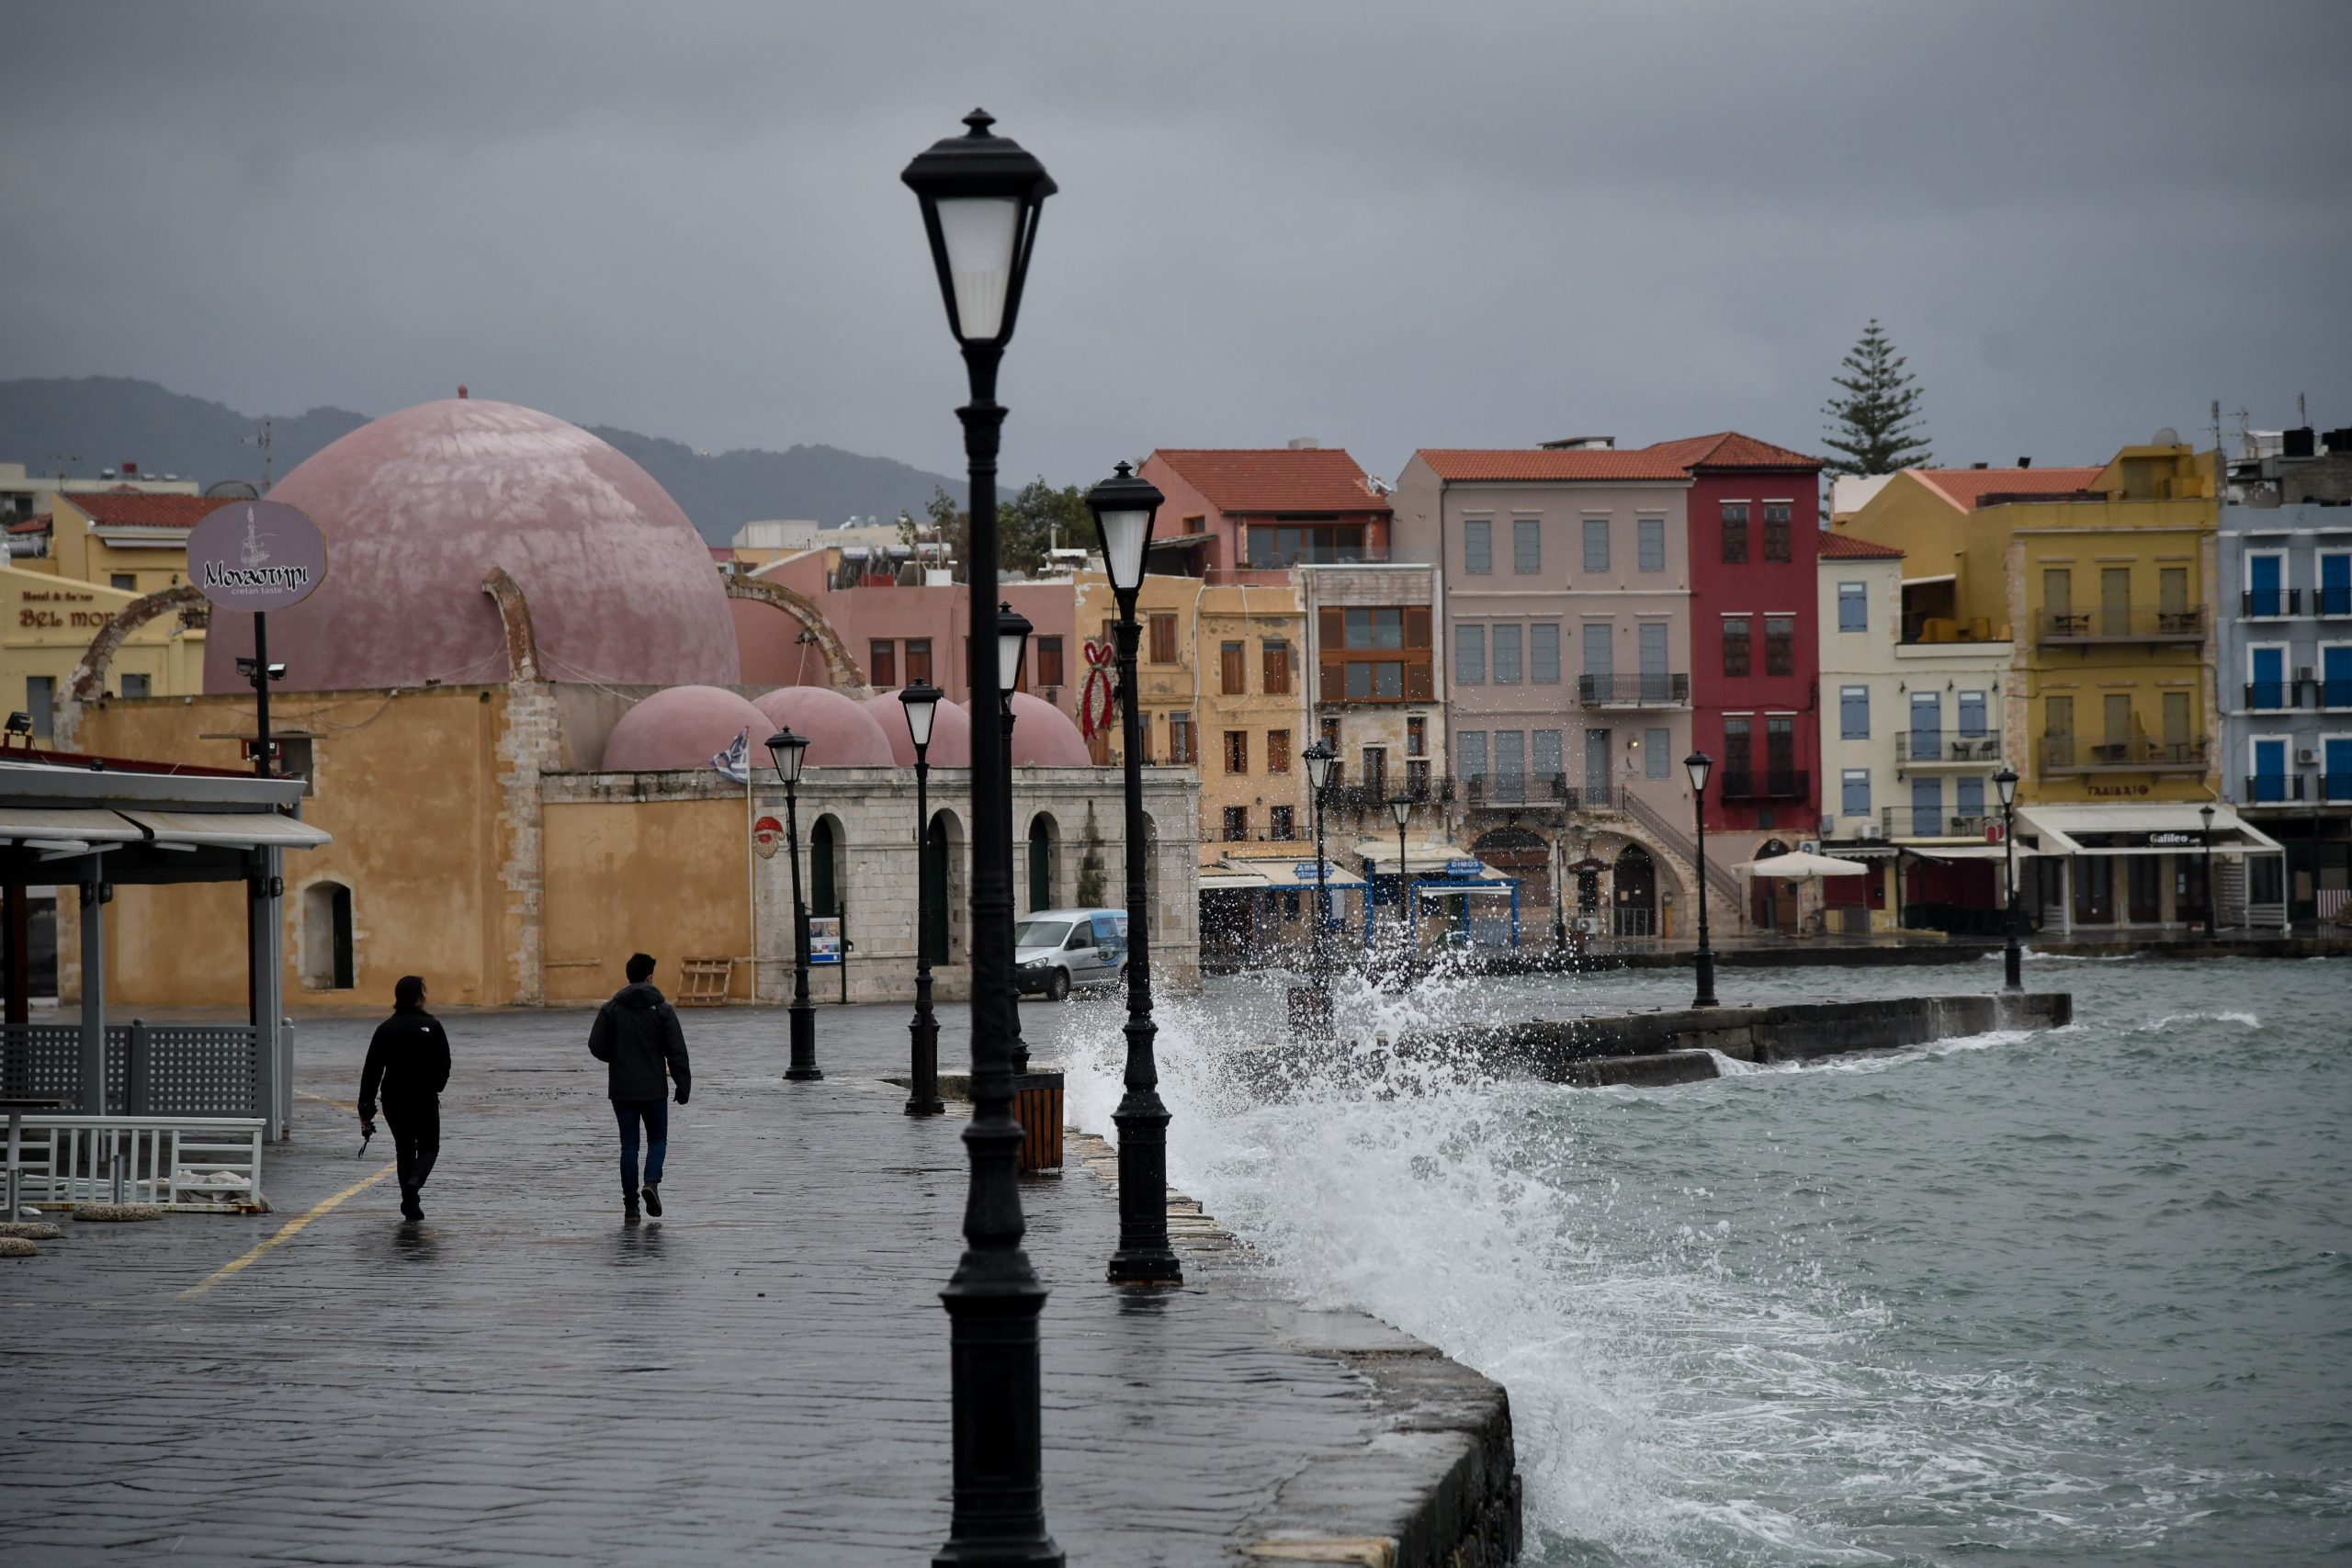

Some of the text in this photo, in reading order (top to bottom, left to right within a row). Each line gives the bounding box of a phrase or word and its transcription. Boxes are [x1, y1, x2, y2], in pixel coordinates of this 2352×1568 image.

[23, 591, 50, 601] Hotel
[53, 592, 61, 601] &
[232, 587, 282, 595] cretan taste
[2150, 833, 2188, 843] Galileo
